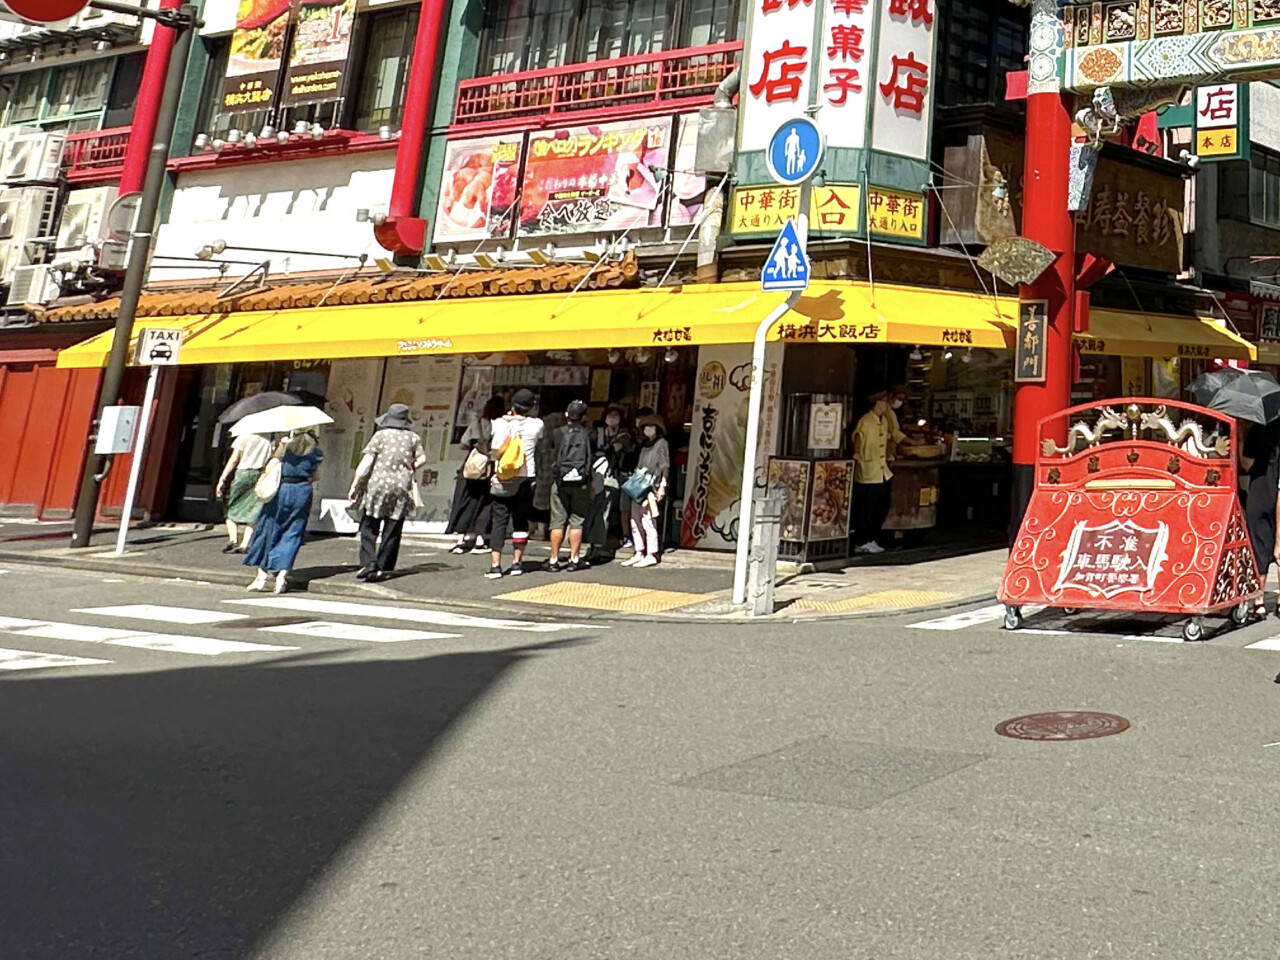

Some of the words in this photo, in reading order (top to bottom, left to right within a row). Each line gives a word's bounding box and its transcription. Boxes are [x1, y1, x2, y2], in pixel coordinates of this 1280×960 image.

[1201, 134, 1233, 150] 本店
[740, 189, 797, 211] 中華街
[820, 190, 851, 225] 入口
[869, 192, 919, 219] 中華街
[150, 331, 180, 340] TAXI
[777, 324, 882, 340] 横浜大飯店
[1093, 535, 1139, 551] 不准
[1073, 553, 1147, 571] 車馬駛入
